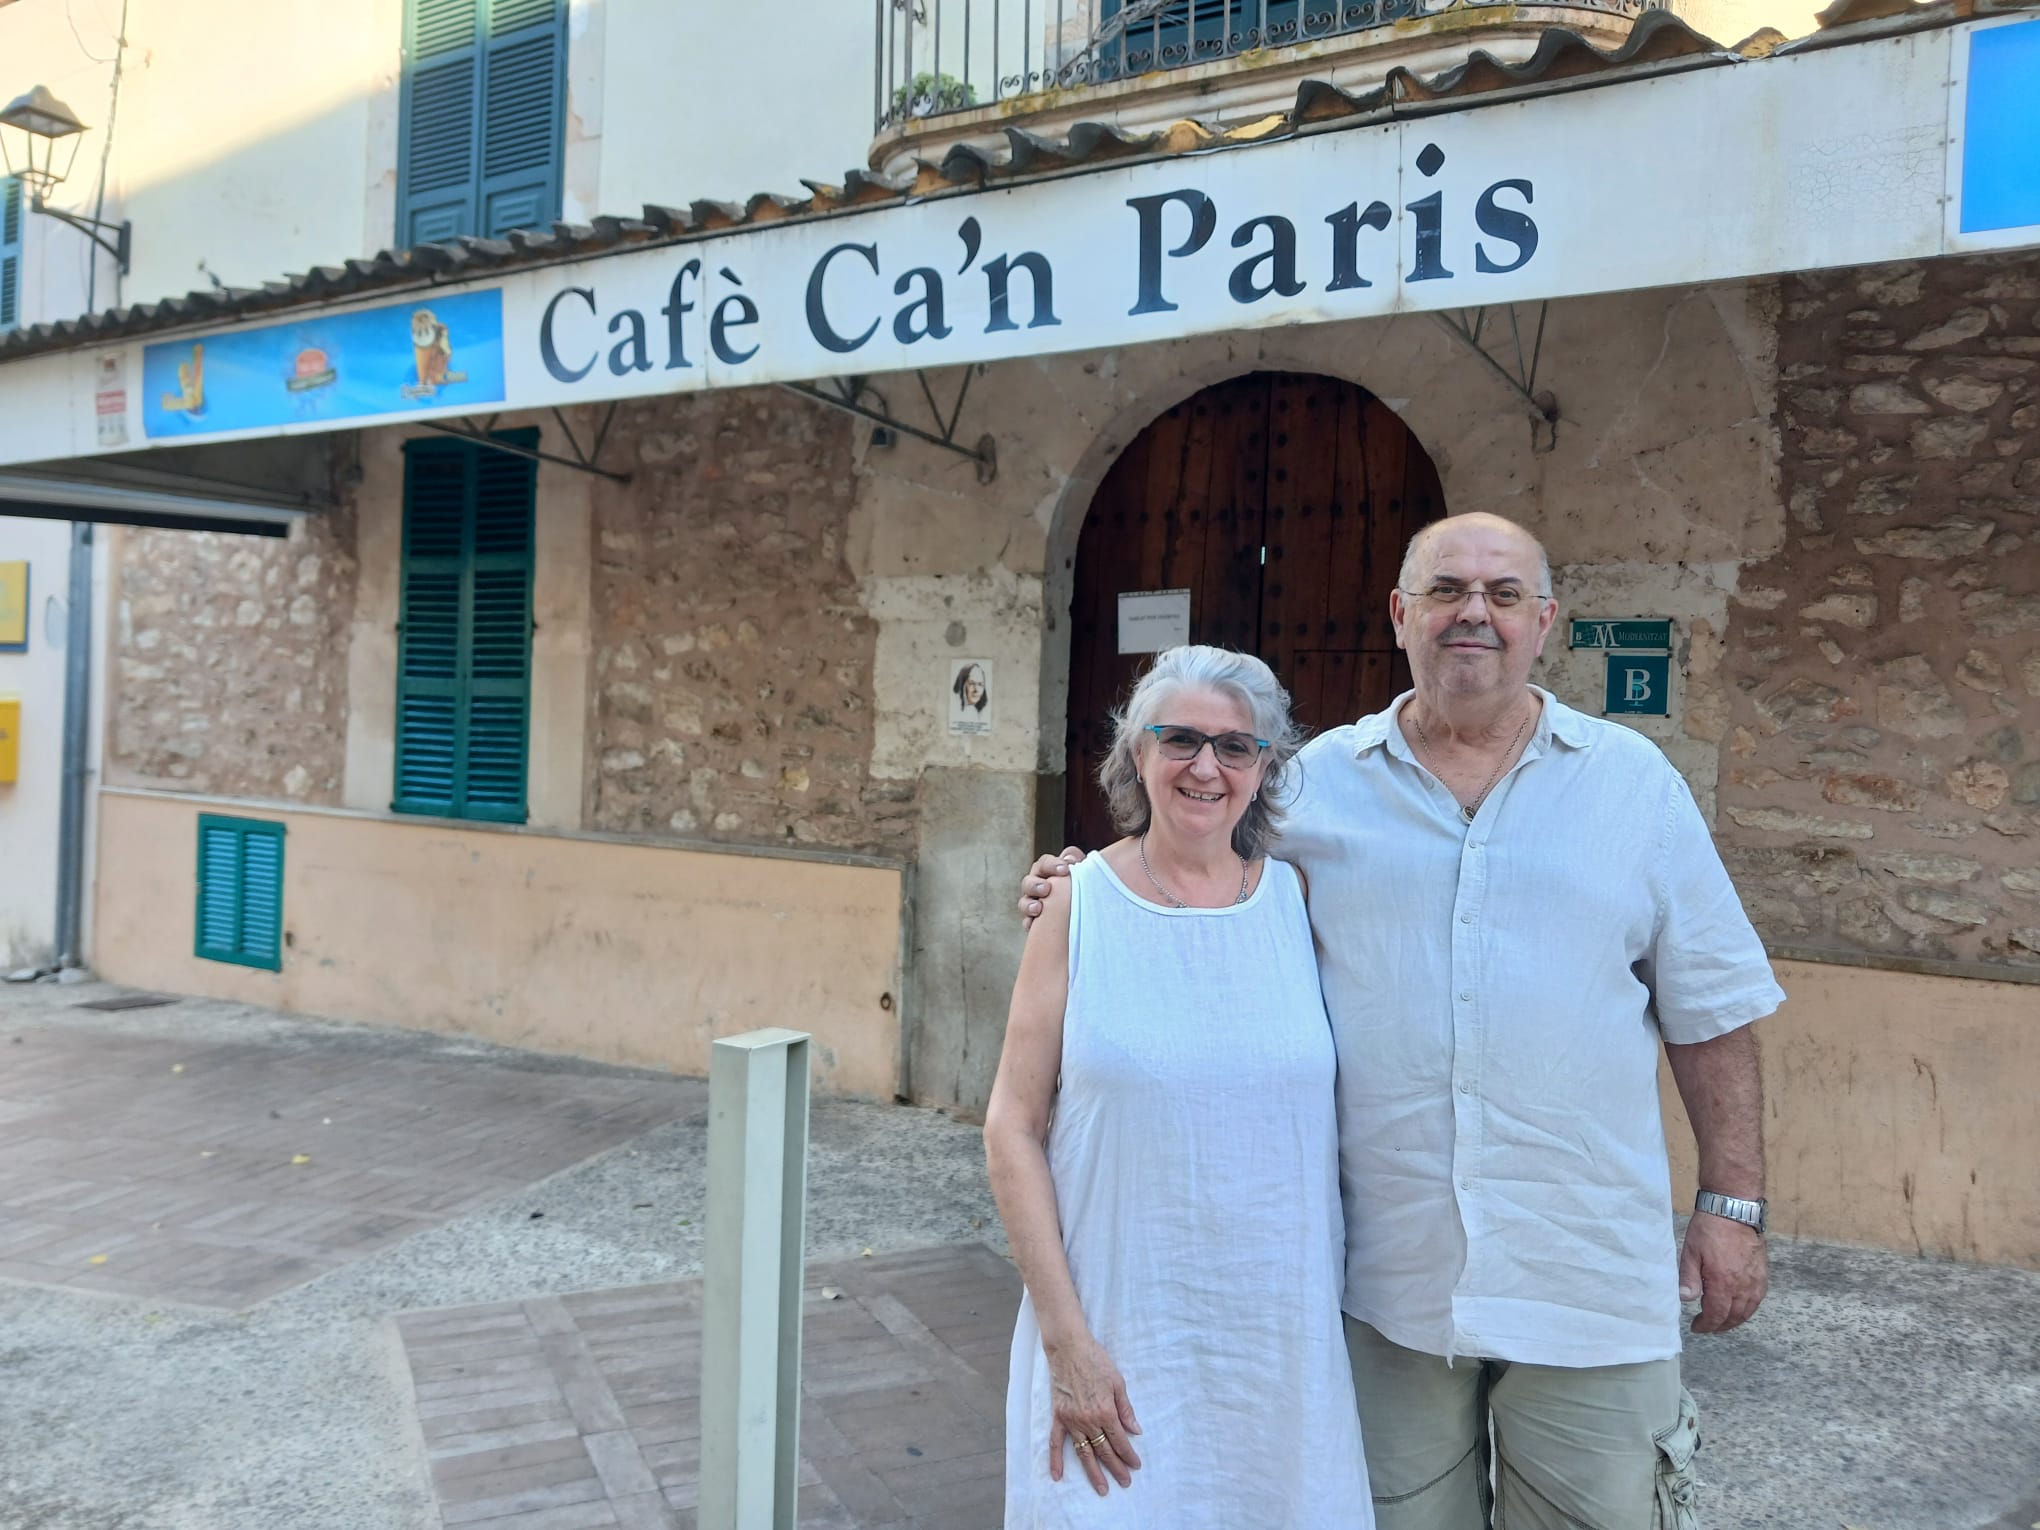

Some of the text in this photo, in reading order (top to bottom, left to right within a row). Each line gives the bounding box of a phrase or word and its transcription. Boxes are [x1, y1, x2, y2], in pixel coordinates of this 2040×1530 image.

[539, 142, 1539, 384] Cafè Ca'n Paris
[1623, 668, 1651, 701] B
